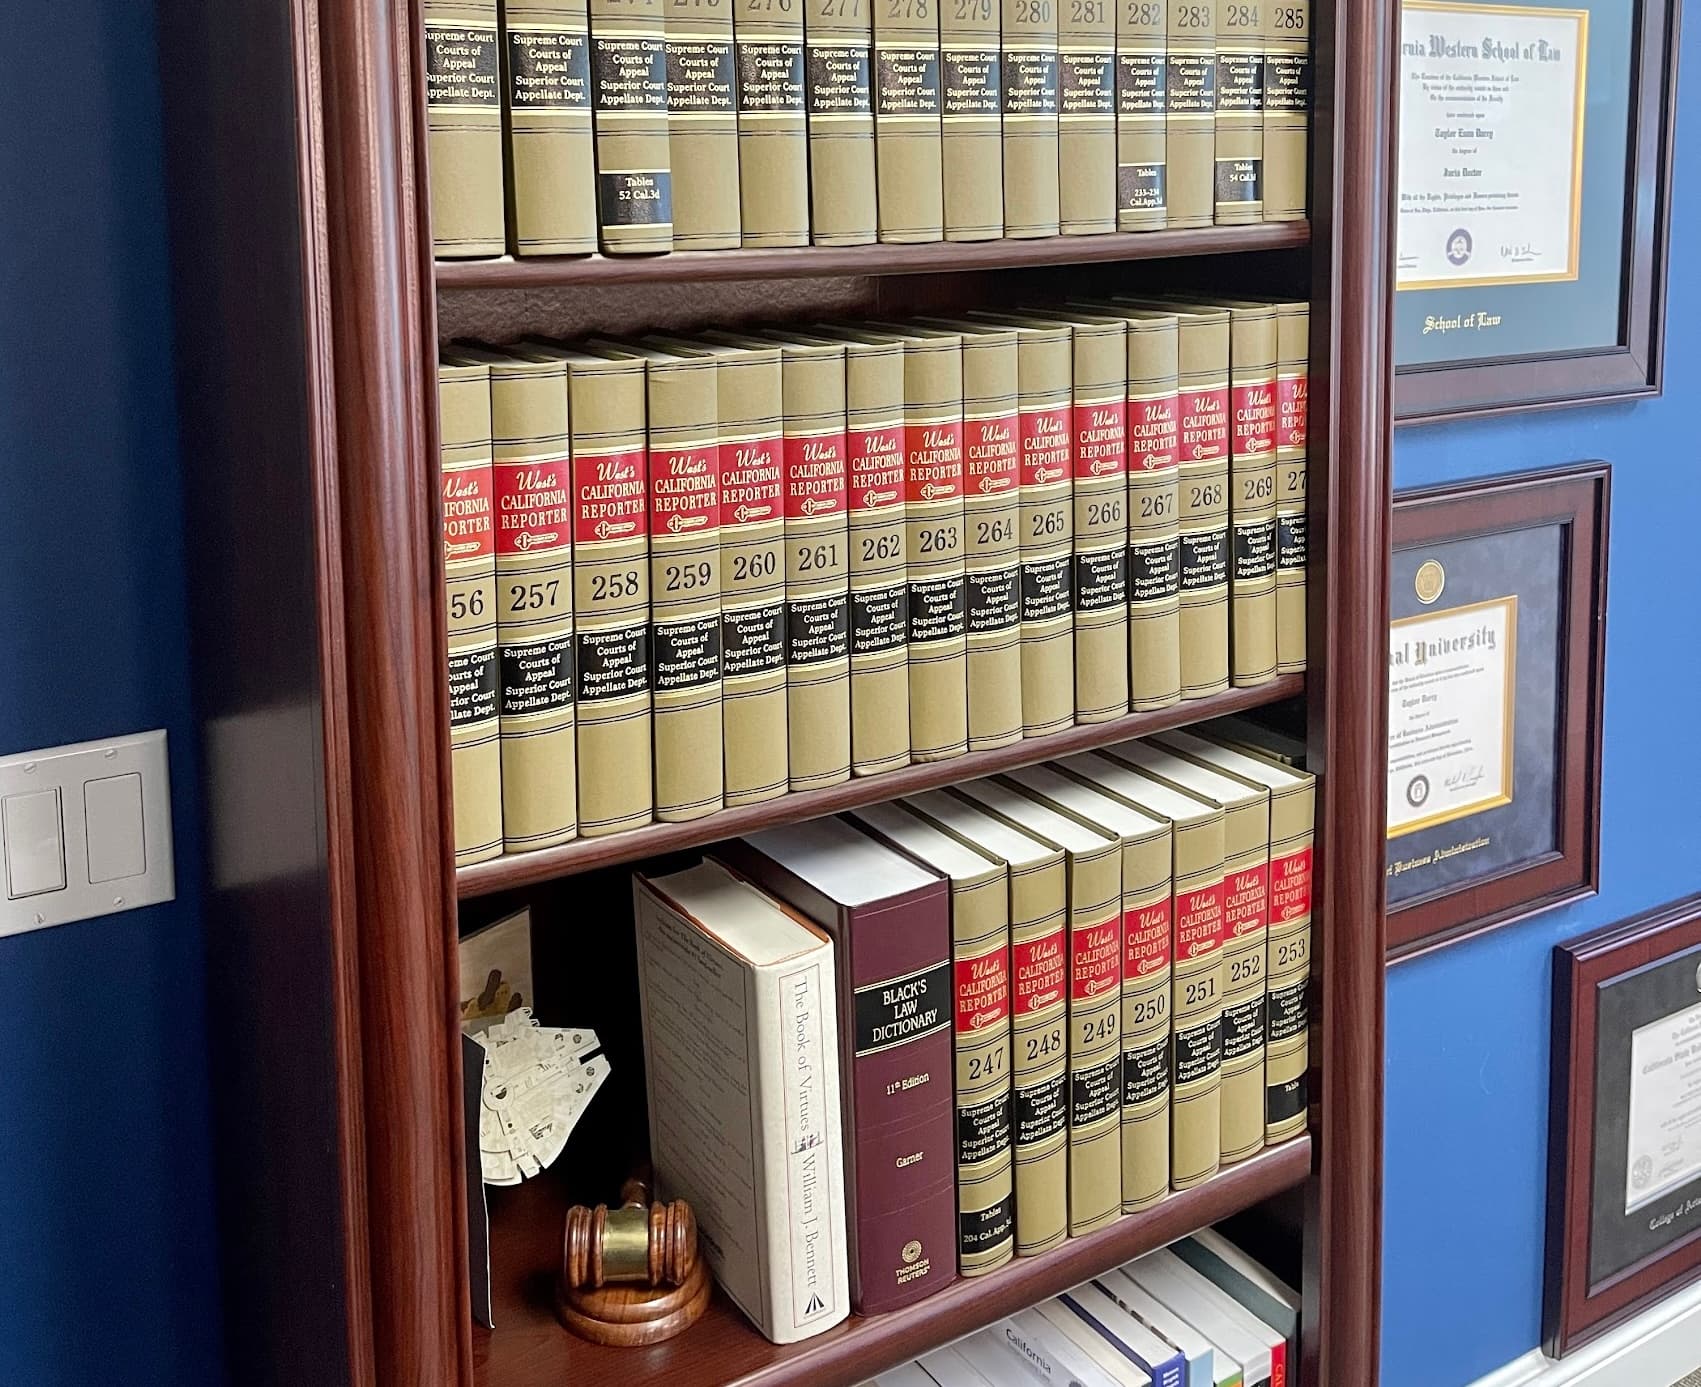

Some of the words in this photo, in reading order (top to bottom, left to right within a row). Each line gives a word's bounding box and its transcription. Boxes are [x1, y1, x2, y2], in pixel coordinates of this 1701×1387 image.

[888, 0, 928, 19] 278
[954, 0, 991, 21] 279
[1015, 1, 1050, 24] 280
[1071, 1, 1105, 24] 281
[1128, 3, 1161, 26] 282
[1178, 7, 1211, 29] 283
[1227, 4, 1259, 28] 284
[1274, 8, 1304, 30] 285
[514, 35, 557, 47] Supreme
[559, 36, 583, 46] Court
[598, 41, 640, 52] Supreme
[641, 41, 663, 52] Court
[1429, 34, 1478, 59] Western
[1482, 37, 1519, 62] School
[1524, 43, 1535, 60] of
[1538, 39, 1561, 61] Law
[529, 49, 560, 60] Courts
[561, 50, 572, 60] of
[612, 54, 642, 65] Courts
[644, 54, 654, 65] of
[535, 61, 568, 73] Appeal
[619, 67, 649, 78] Appeal
[516, 76, 558, 87] Superior
[560, 77, 584, 88] Court
[600, 81, 641, 91] Superior
[643, 81, 665, 91] Court
[515, 89, 563, 102] Appellate
[565, 90, 586, 103] Dept.
[600, 93, 644, 105] Appellate
[1137, 169, 1157, 177] Tables
[1230, 174, 1239, 182] 54
[1234, 163, 1253, 172] Tables
[625, 177, 654, 187] Tables
[619, 191, 631, 200] 52
[633, 188, 660, 200] Cal.3d
[1422, 314, 1461, 335] School
[1464, 313, 1476, 328] of
[1477, 312, 1502, 331] Law
[865, 436, 897, 453] West's
[923, 431, 954, 448] West's
[736, 449, 771, 467] West's
[803, 443, 836, 462] West's
[852, 453, 904, 472] CALIFORNIA
[910, 448, 961, 465] CALIFORNIA
[597, 463, 635, 482] West's
[669, 455, 707, 475] West's
[790, 460, 844, 479] CALIFORNIA
[910, 463, 962, 481] REPORTER
[516, 470, 557, 491] West's
[655, 475, 716, 494] CALIFORNIA
[722, 467, 781, 486] CALIFORNIA
[790, 477, 845, 496] REPORTER
[852, 469, 905, 489] REPORTER
[581, 480, 645, 500] CALIFORNIA
[722, 484, 781, 504] REPORTER
[1190, 484, 1222, 508] 268
[1244, 476, 1273, 500] 269
[501, 490, 567, 510] CALIFORNIA
[582, 499, 645, 519] REPORTER
[655, 492, 717, 512] REPORTER
[1141, 493, 1174, 518] 267
[501, 508, 567, 530] REPORTER
[1032, 510, 1064, 538] 265
[1088, 500, 1121, 526] 266
[920, 527, 958, 553] 263
[977, 518, 1013, 544] 264
[798, 544, 838, 571] 261
[862, 534, 900, 561] 262
[666, 562, 712, 591] 259
[733, 552, 776, 581] 260
[511, 580, 560, 611] 257
[591, 572, 639, 601] 258
[503, 646, 546, 659] Supreme
[548, 640, 571, 651] Court
[1415, 625, 1496, 667] University
[519, 658, 549, 670] Courts
[551, 655, 561, 665] of
[525, 667, 556, 681] Appeal
[505, 683, 547, 696] Superior
[549, 677, 571, 688] Court
[505, 694, 549, 709] Appellate
[551, 691, 571, 703] Dept.
[1394, 856, 1431, 876] Business
[1432, 837, 1490, 864] Administration
[1225, 884, 1265, 909] CALIFORNIA
[1180, 904, 1221, 928] CALIFORNIA
[1226, 899, 1266, 923] REPORTER
[1128, 921, 1169, 946] CALIFORNIA
[1180, 919, 1222, 943] REPORTER
[1076, 940, 1119, 965] CALIFORNIA
[1128, 935, 1169, 960] REPORTER
[1279, 938, 1305, 966] 253
[1018, 953, 1064, 980] CALIFORNIA
[1076, 955, 1120, 980] REPORTER
[1232, 955, 1260, 982] 252
[794, 976, 808, 1009] The
[883, 979, 927, 1005] BLACK'S
[959, 970, 1007, 997] CALIFORNIA
[1018, 968, 1064, 996] REPORTER
[1186, 978, 1215, 1005] 251
[894, 999, 918, 1019] LAW
[960, 985, 1007, 1013] REPORTER
[1135, 994, 1165, 1024] 250
[796, 1012, 810, 1052] Book
[872, 1008, 938, 1042] DICTIONARY
[1084, 1014, 1115, 1043] 249
[1027, 1030, 1060, 1062] 248
[798, 1056, 812, 1070] of
[968, 1047, 1004, 1080] 247
[902, 1073, 929, 1090] Edition
[800, 1075, 812, 1131] Virtues
[896, 1152, 924, 1168] Garner
[802, 1153, 817, 1214] William
[801, 1217, 817, 1229] J.
[980, 1206, 1002, 1222] Tables
[963, 1234, 978, 1243] 204
[805, 1230, 819, 1287] Bennett
[896, 1258, 930, 1277] THOMSON
[1005, 1328, 1052, 1374] California
